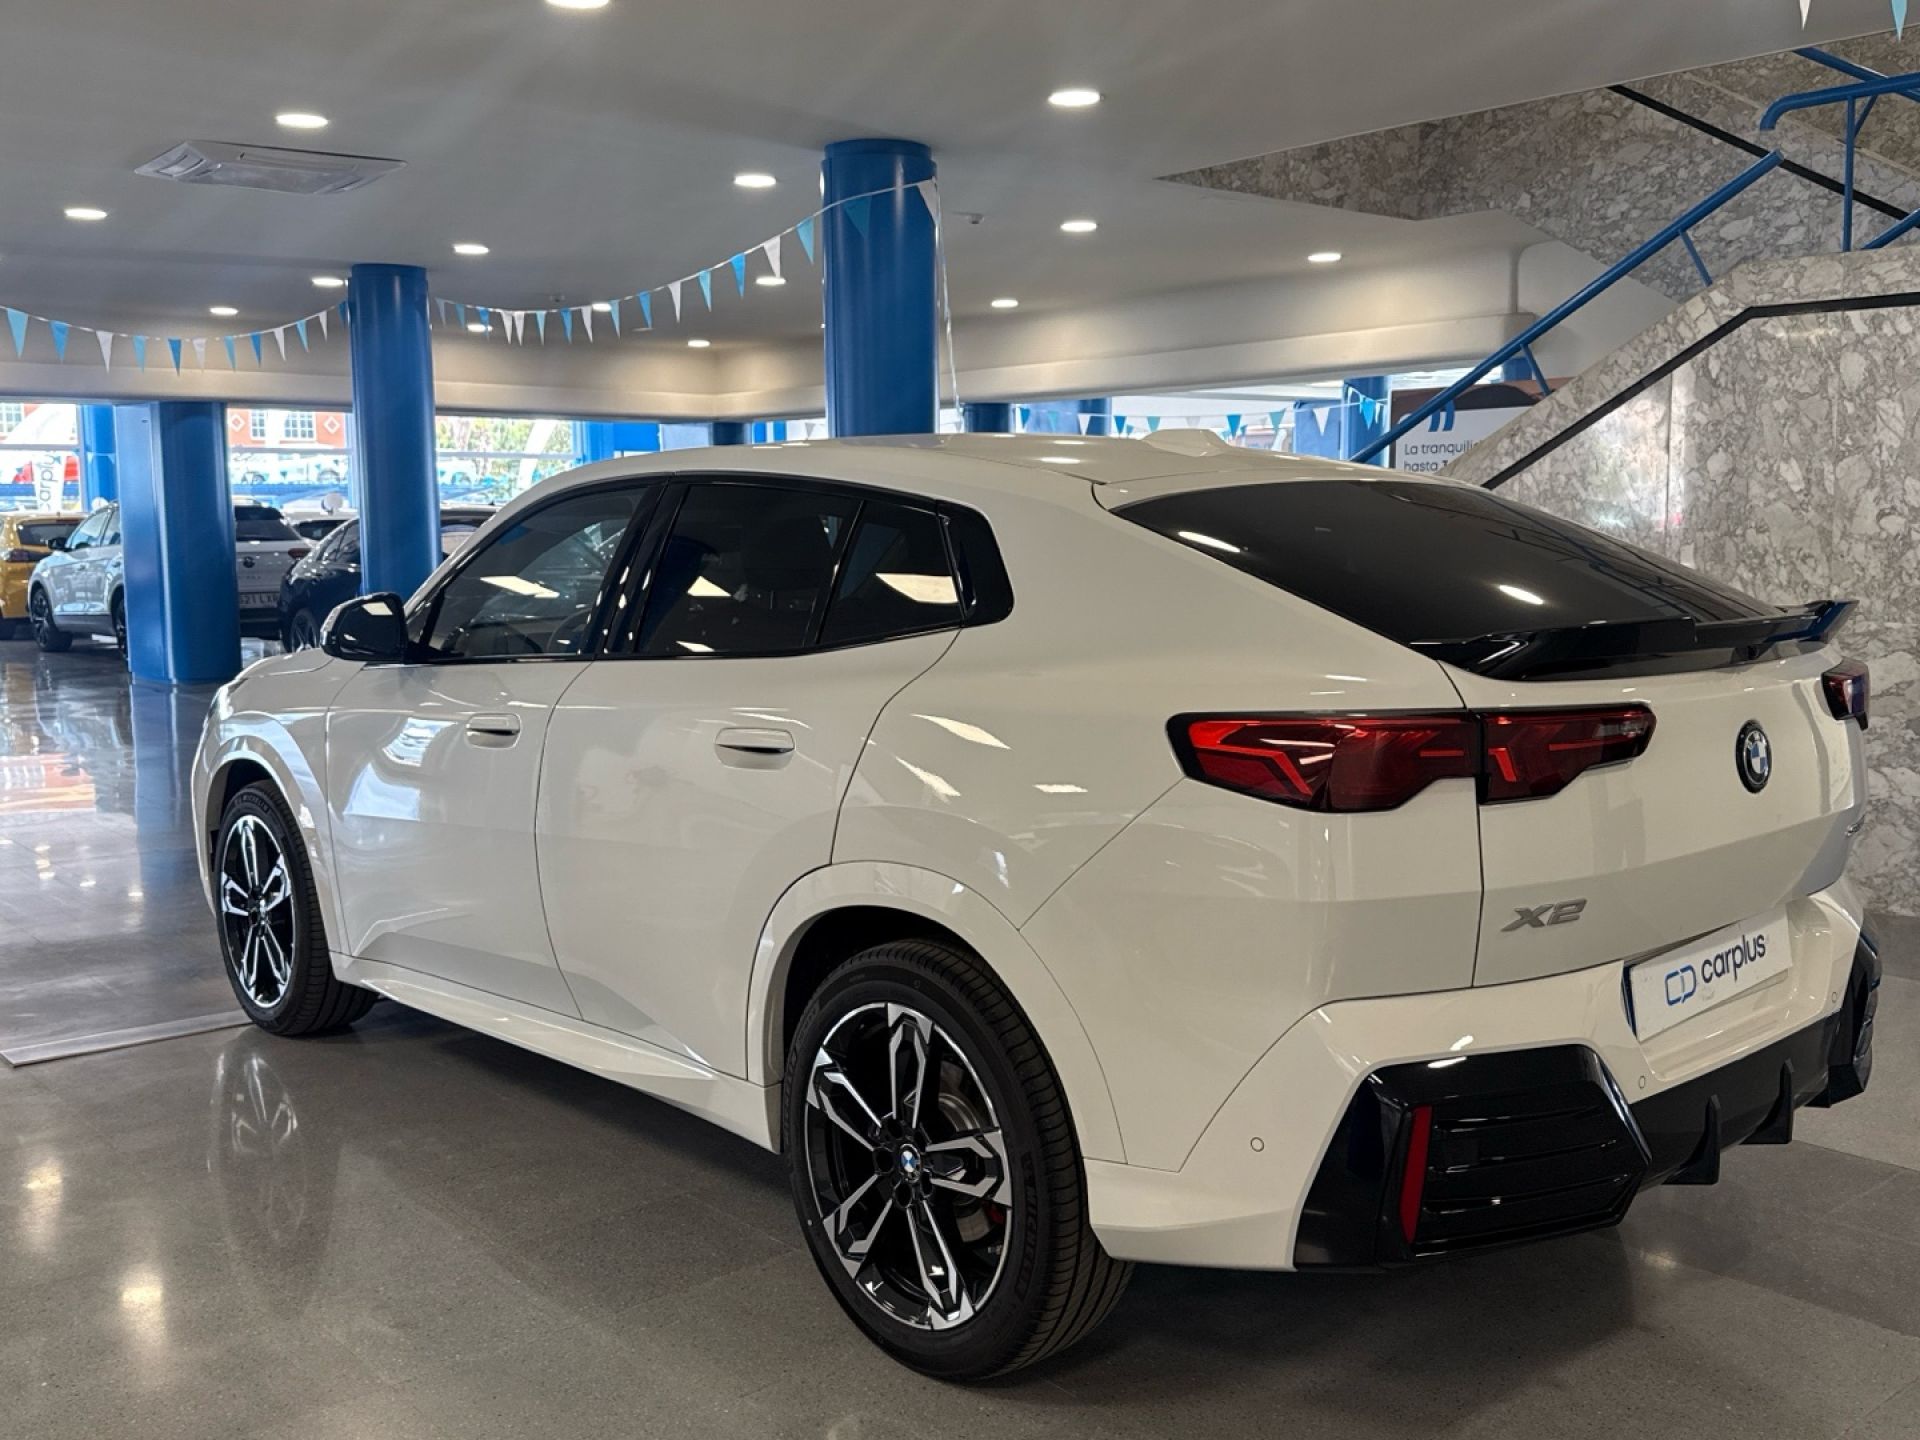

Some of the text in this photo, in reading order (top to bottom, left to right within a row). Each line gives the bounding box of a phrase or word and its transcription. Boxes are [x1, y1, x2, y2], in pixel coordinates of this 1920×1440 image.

[1404, 444, 1418, 455] La
[1404, 460, 1438, 472] hasta
[1501, 898, 1588, 932] X2
[1701, 933, 1766, 983] carplus
